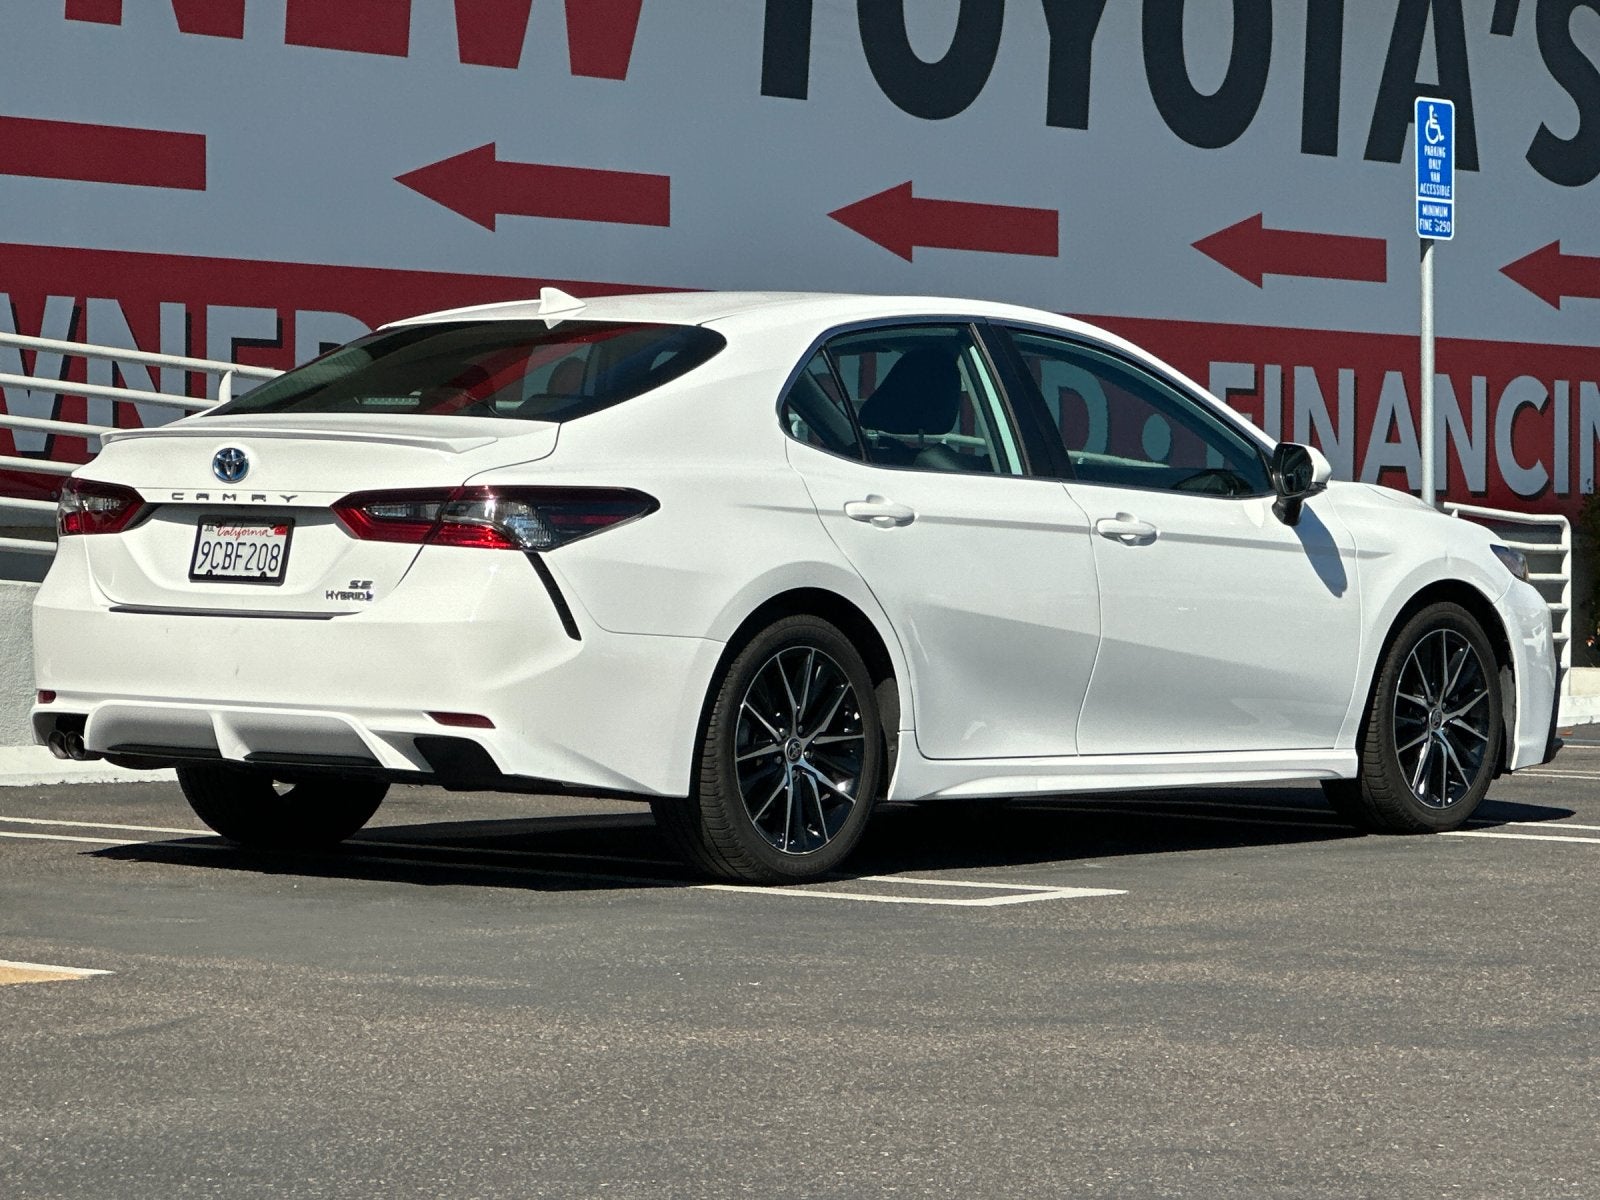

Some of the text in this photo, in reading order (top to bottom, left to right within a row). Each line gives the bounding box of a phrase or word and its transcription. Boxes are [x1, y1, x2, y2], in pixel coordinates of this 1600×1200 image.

[1424, 145, 1446, 158] PARKING
[1429, 158, 1441, 170] ONLY
[1430, 171, 1441, 183] VAN
[1420, 183, 1450, 196] ACCESSIBLE
[1422, 204, 1448, 217] MINIMUM
[1420, 218, 1433, 231] FINE
[171, 492, 299, 503] CAMRY
[217, 523, 273, 540] California
[198, 541, 281, 572] 9CBF208
[348, 579, 373, 590] SE
[325, 590, 366, 601] HYBRID
